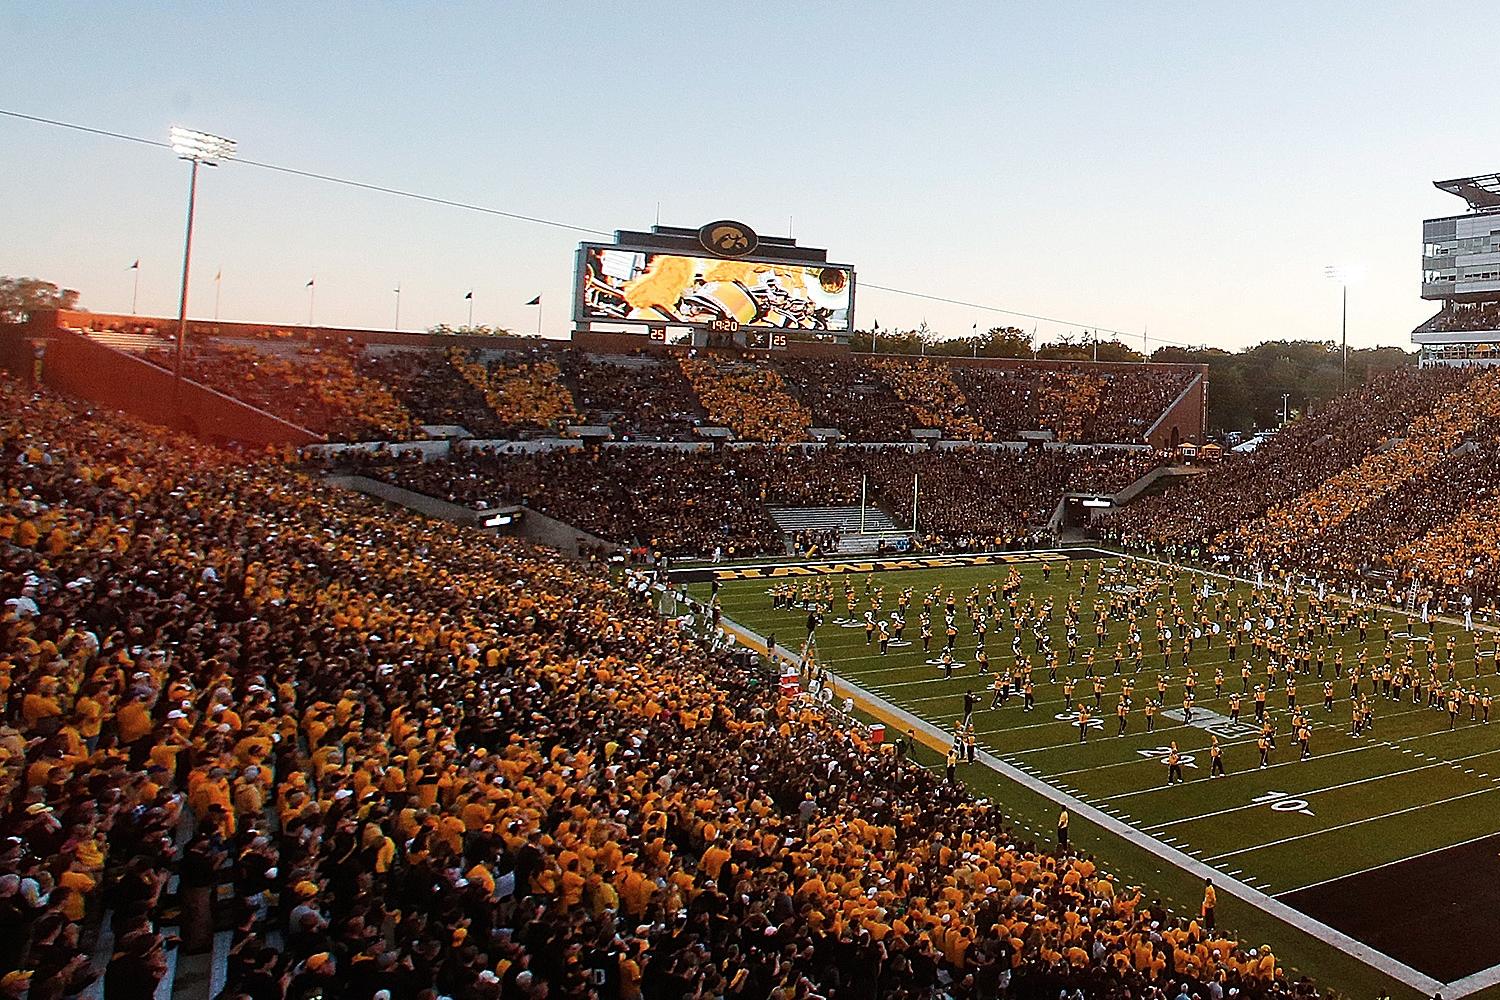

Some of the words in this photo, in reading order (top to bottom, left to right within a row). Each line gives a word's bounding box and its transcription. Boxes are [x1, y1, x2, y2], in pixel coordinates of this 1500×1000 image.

[712, 320, 738, 332] 19:20
[650, 328, 664, 340] 25
[773, 335, 787, 346] 25
[713, 552, 1071, 580] HAWKEYES
